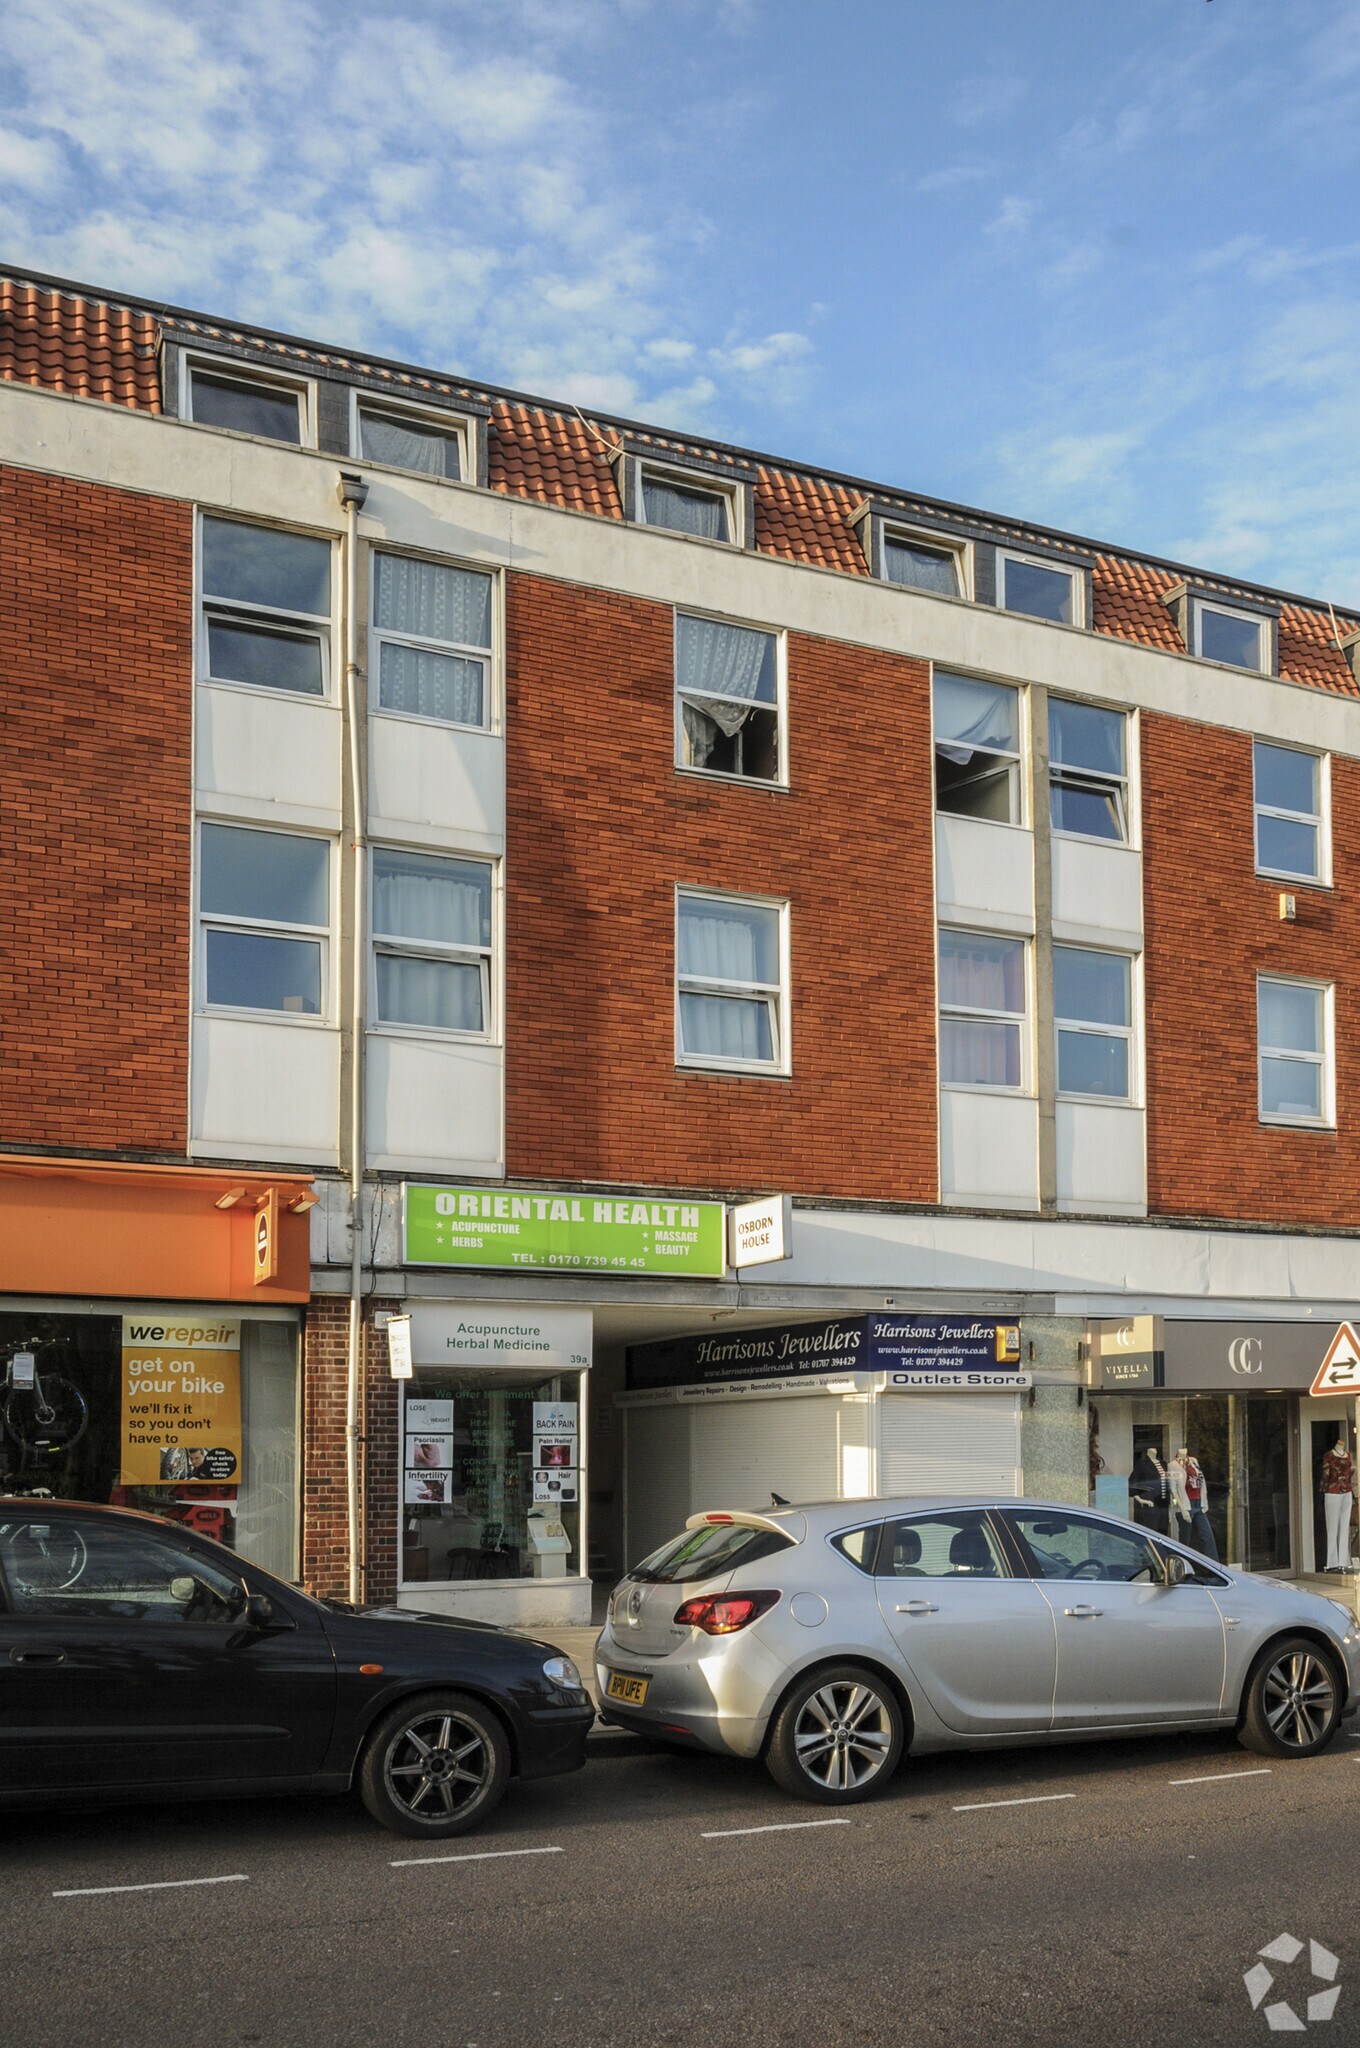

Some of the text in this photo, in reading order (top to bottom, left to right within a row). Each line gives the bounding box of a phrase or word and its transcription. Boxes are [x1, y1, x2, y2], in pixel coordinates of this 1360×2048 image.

[435, 1192, 699, 1228] ORIENTAL HEALTH
[452, 1221, 520, 1234] ACUPUNCTURE
[738, 1215, 774, 1235] OSBORN
[452, 1236, 484, 1248] HERBS
[654, 1230, 698, 1243] MASSAGE
[742, 1233, 771, 1249] HOUSE
[655, 1244, 690, 1256] BEAUTY
[512, 1253, 537, 1263] TEL
[549, 1254, 580, 1265] 0170
[585, 1255, 608, 1266] 739
[611, 1256, 627, 1267] 45
[630, 1257, 646, 1267] 45
[457, 1323, 541, 1336] Acupuncture
[873, 1323, 936, 1339] Harrisons
[938, 1323, 995, 1340] Jewellers
[446, 1338, 550, 1351] Herbal Medicine
[697, 1324, 862, 1364] Harrisons Jewellers
[570, 1355, 587, 1364] 39a
[799, 1360, 810, 1370] Tel:
[811, 1358, 830, 1369] 01707
[831, 1356, 856, 1368] 394429
[901, 1357, 963, 1366] Tel: 01707 394429
[128, 1358, 195, 1376] get on
[1106, 1364, 1148, 1374] VIYELLA
[730, 1384, 747, 1392] Design
[786, 1379, 815, 1388] Handmade
[893, 1374, 1026, 1385] Outlet Store
[128, 1377, 225, 1396] your bike
[435, 1389, 452, 1399] We
[456, 1389, 479, 1399] offer
[129, 1403, 192, 1414] we'll fix it
[129, 1418, 211, 1430] so you don't
[536, 1420, 575, 1429] BACK PAIN
[129, 1433, 178, 1444] have to
[408, 1471, 448, 1480] Infertility
[535, 1492, 551, 1500] Loss
